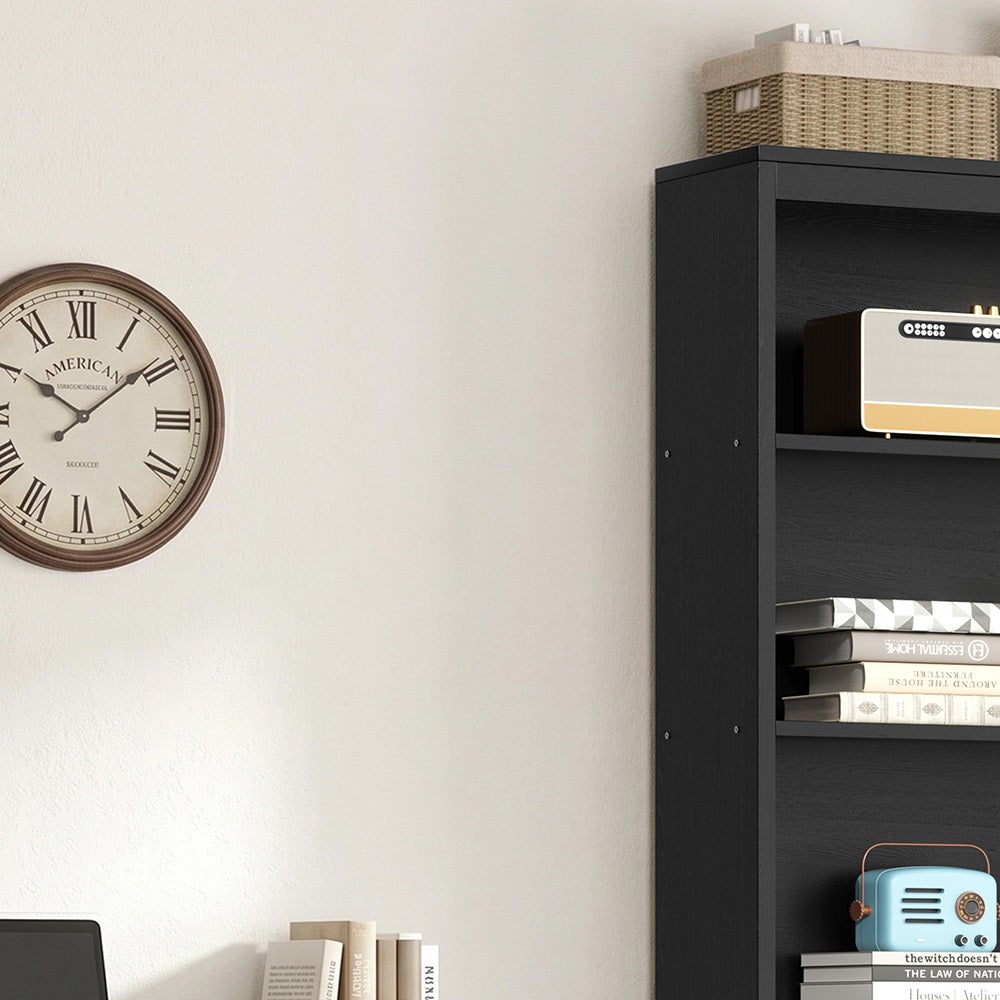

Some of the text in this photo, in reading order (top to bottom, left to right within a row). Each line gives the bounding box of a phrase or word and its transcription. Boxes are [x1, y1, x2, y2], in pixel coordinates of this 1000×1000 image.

[16, 309, 54, 353] XI
[66, 300, 98, 340] XII
[115, 316, 140, 352] I
[45, 357, 123, 384] AMERICAN
[154, 406, 191, 432] III
[143, 448, 181, 487] IV
[17, 476, 52, 523] VII
[118, 486, 143, 523] V
[71, 494, 94, 534] VI
[885, 642, 915, 654] HOME
[918, 644, 963, 656] ESSENTIAL
[888, 678, 998, 689] AROUND THE HOUSE
[913, 670, 974, 680] FURNITURE
[905, 969, 926, 979] THE
[930, 969, 952, 979] LAW
[956, 970, 969, 979] OF
[910, 988, 950, 1000] Houses
[963, 989, 1000, 1000] Atelier
